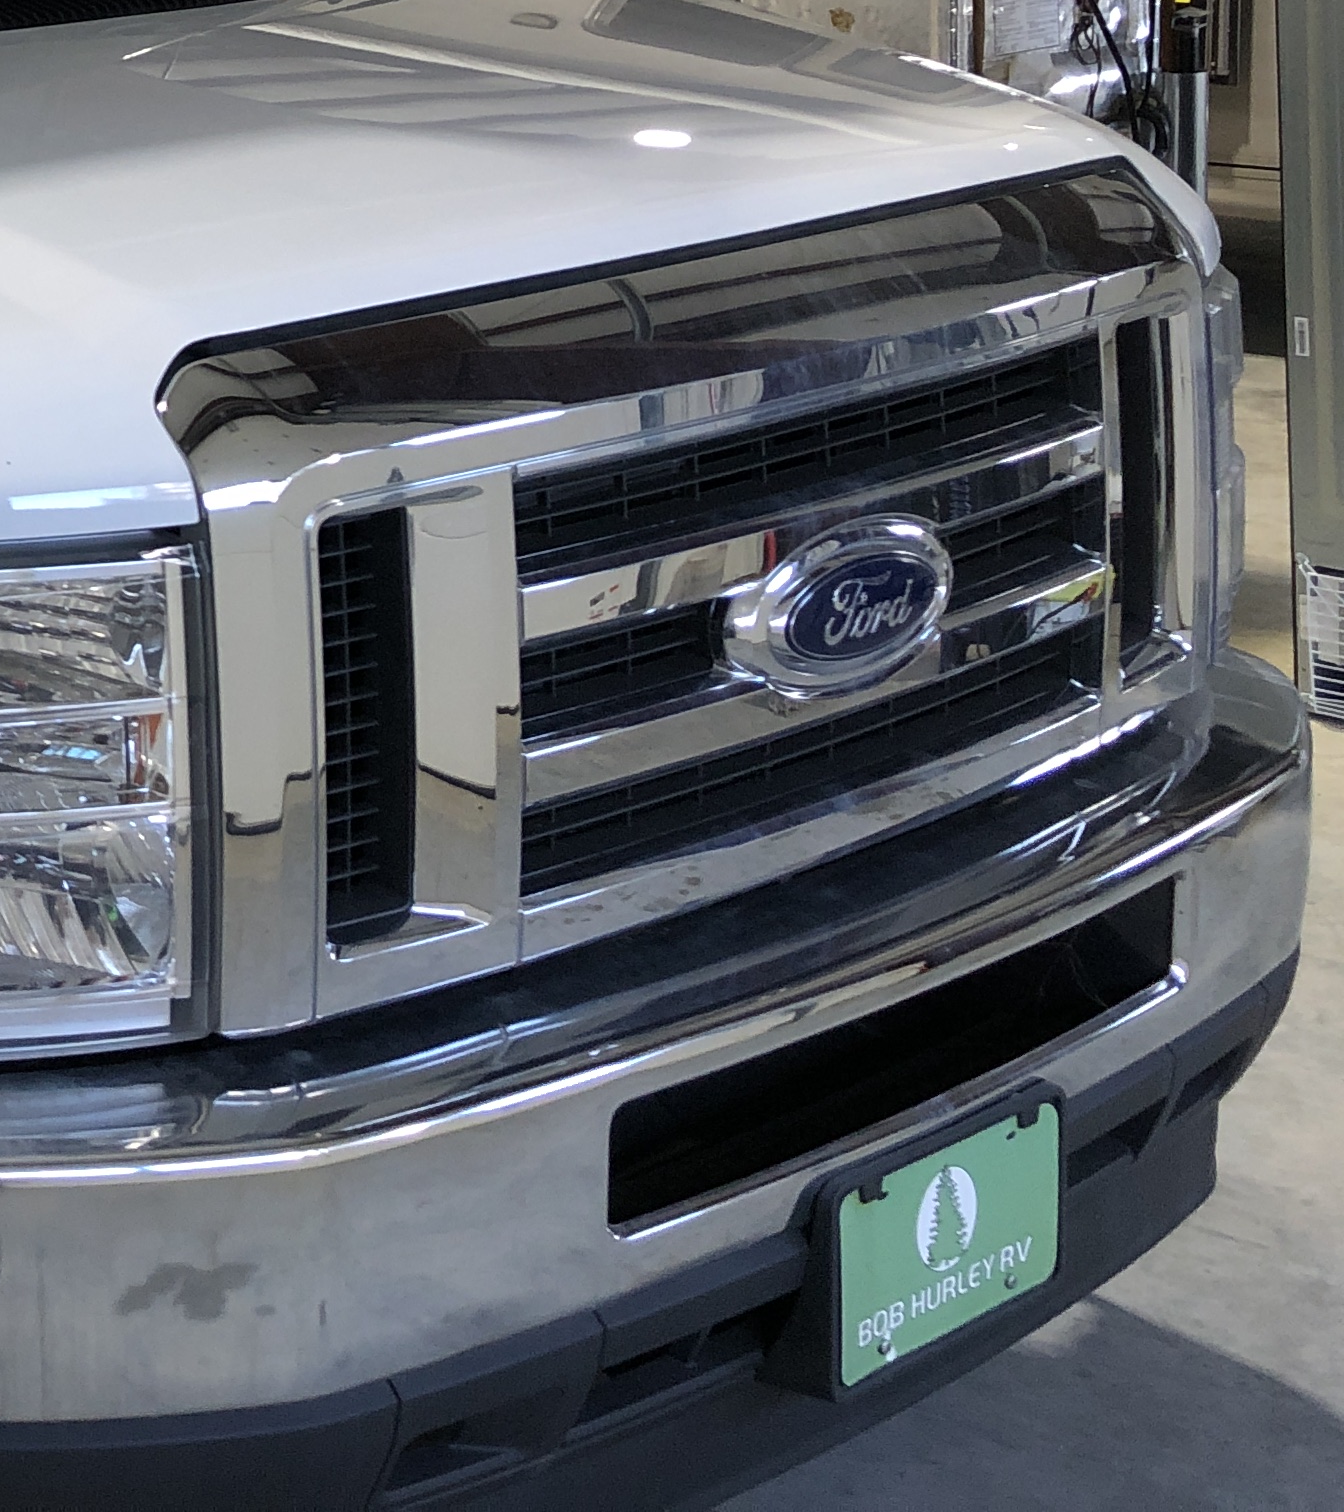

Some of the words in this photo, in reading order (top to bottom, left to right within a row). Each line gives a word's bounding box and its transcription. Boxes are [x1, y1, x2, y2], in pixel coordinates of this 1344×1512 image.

[824, 572, 913, 646] Ford
[857, 1300, 905, 1348] BOB
[912, 1254, 996, 1319] HURLEY
[999, 1236, 1033, 1273] RV
